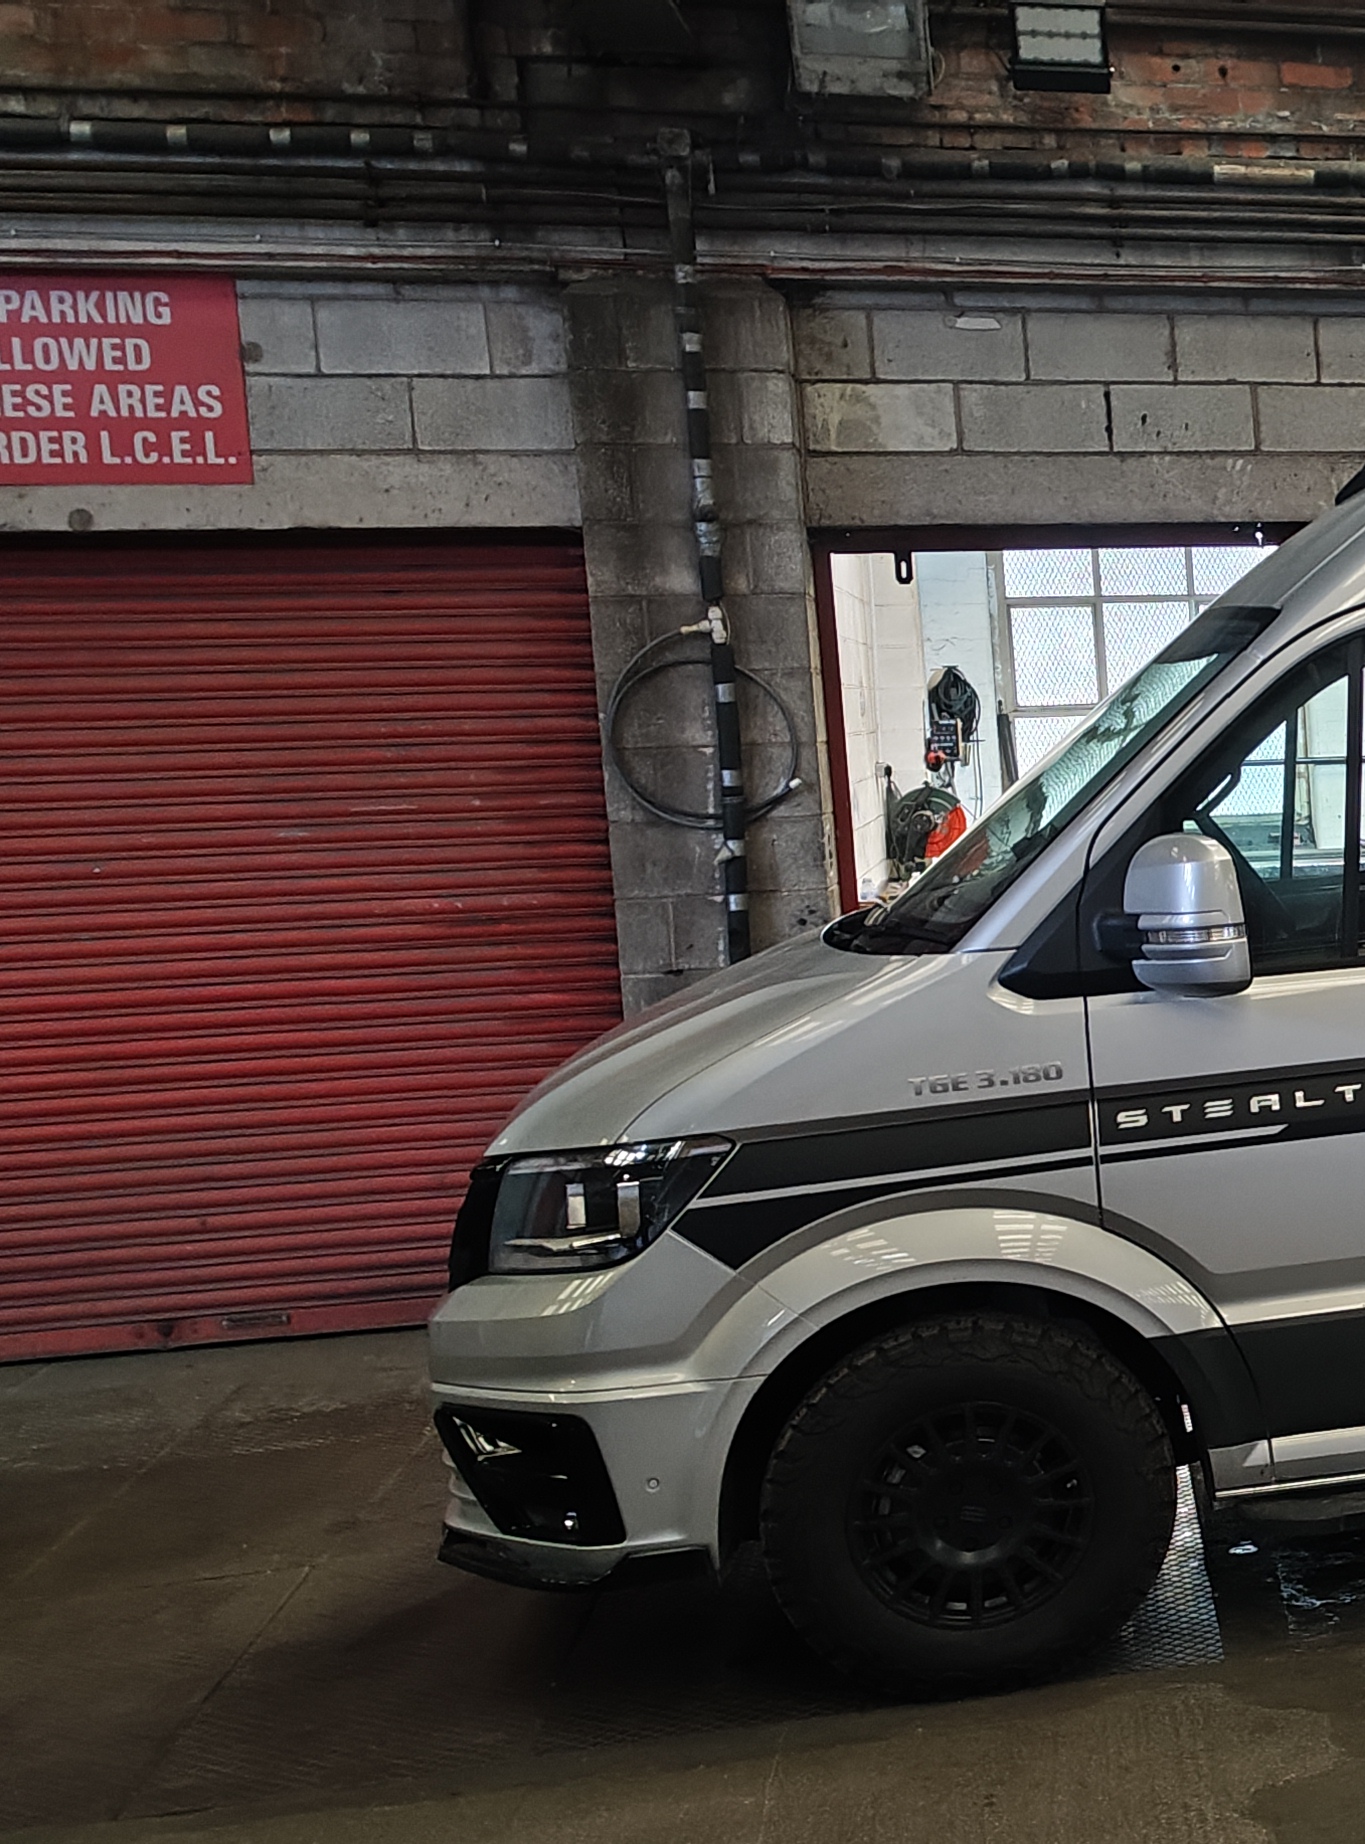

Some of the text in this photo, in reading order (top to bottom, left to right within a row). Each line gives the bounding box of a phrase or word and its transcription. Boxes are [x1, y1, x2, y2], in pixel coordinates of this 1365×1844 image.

[0, 290, 171, 325] PARKING
[0, 384, 223, 418] ESE AREAS
[100, 430, 238, 465] L.C.E.L.
[907, 1061, 1063, 1096] TGE 3.180
